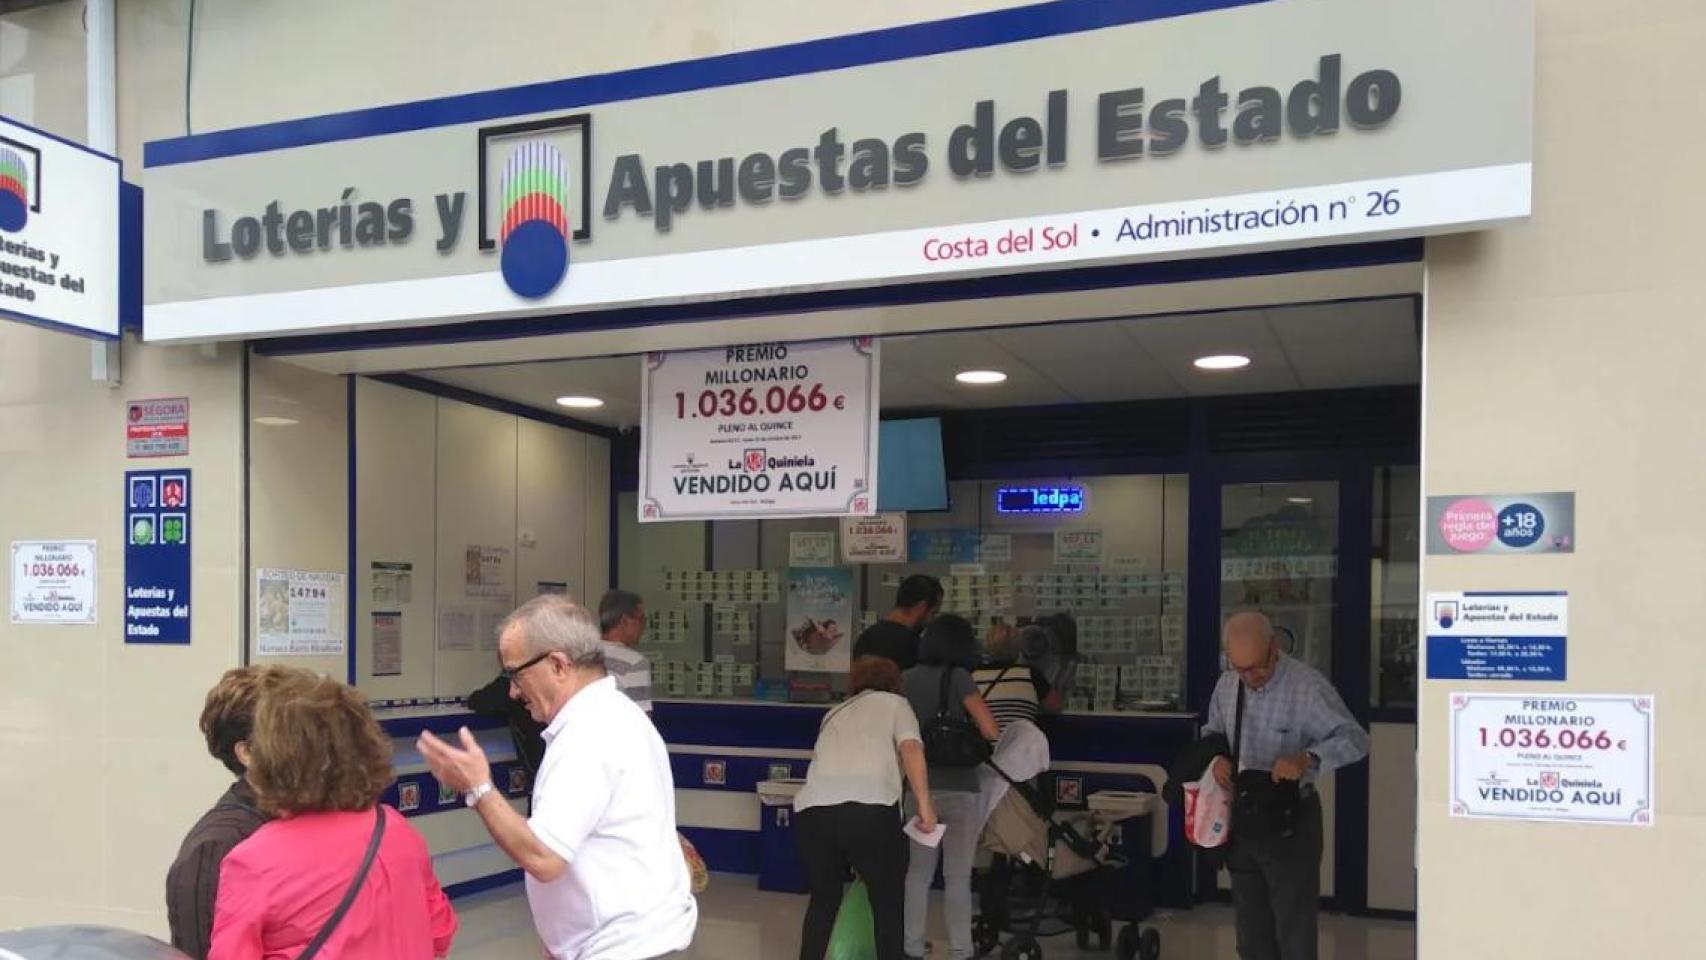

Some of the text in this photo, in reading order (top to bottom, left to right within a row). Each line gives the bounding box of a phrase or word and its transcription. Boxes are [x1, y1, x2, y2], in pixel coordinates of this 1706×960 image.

[202, 53, 1402, 261] Loterías y Apuestas del Estado
[924, 228, 989, 262] Costa
[997, 227, 1034, 254] del
[1042, 223, 1078, 250] Sol
[1116, 200, 1319, 242] Administración
[1366, 190, 1400, 217] 26
[49, 252, 60, 270] y
[59, 274, 85, 294] del
[726, 345, 788, 363] PREMIO
[704, 365, 809, 386] MILLONARIO
[675, 383, 846, 419] 1.036.066 €
[717, 421, 794, 433] PLENO AL QUINCE
[728, 456, 815, 469] La Quiniela
[673, 465, 836, 495] VENDIDO AQUÍ
[1033, 488, 1080, 508] ledpa
[1446, 511, 1493, 521] Primera
[1502, 512, 1536, 528] +18
[1443, 520, 1496, 532] regla del
[1504, 527, 1534, 537] años
[167, 589, 175, 601] y
[127, 605, 188, 619] Apuestas del
[127, 623, 159, 636] Estado
[1523, 700, 1577, 711] PREMIO
[1504, 715, 1595, 727] MILLONARIO
[1479, 727, 1627, 751] 1.036.066 €
[1527, 778, 1602, 788] La Quiniela
[1479, 787, 1622, 805] VENDIDO AQUÍ
